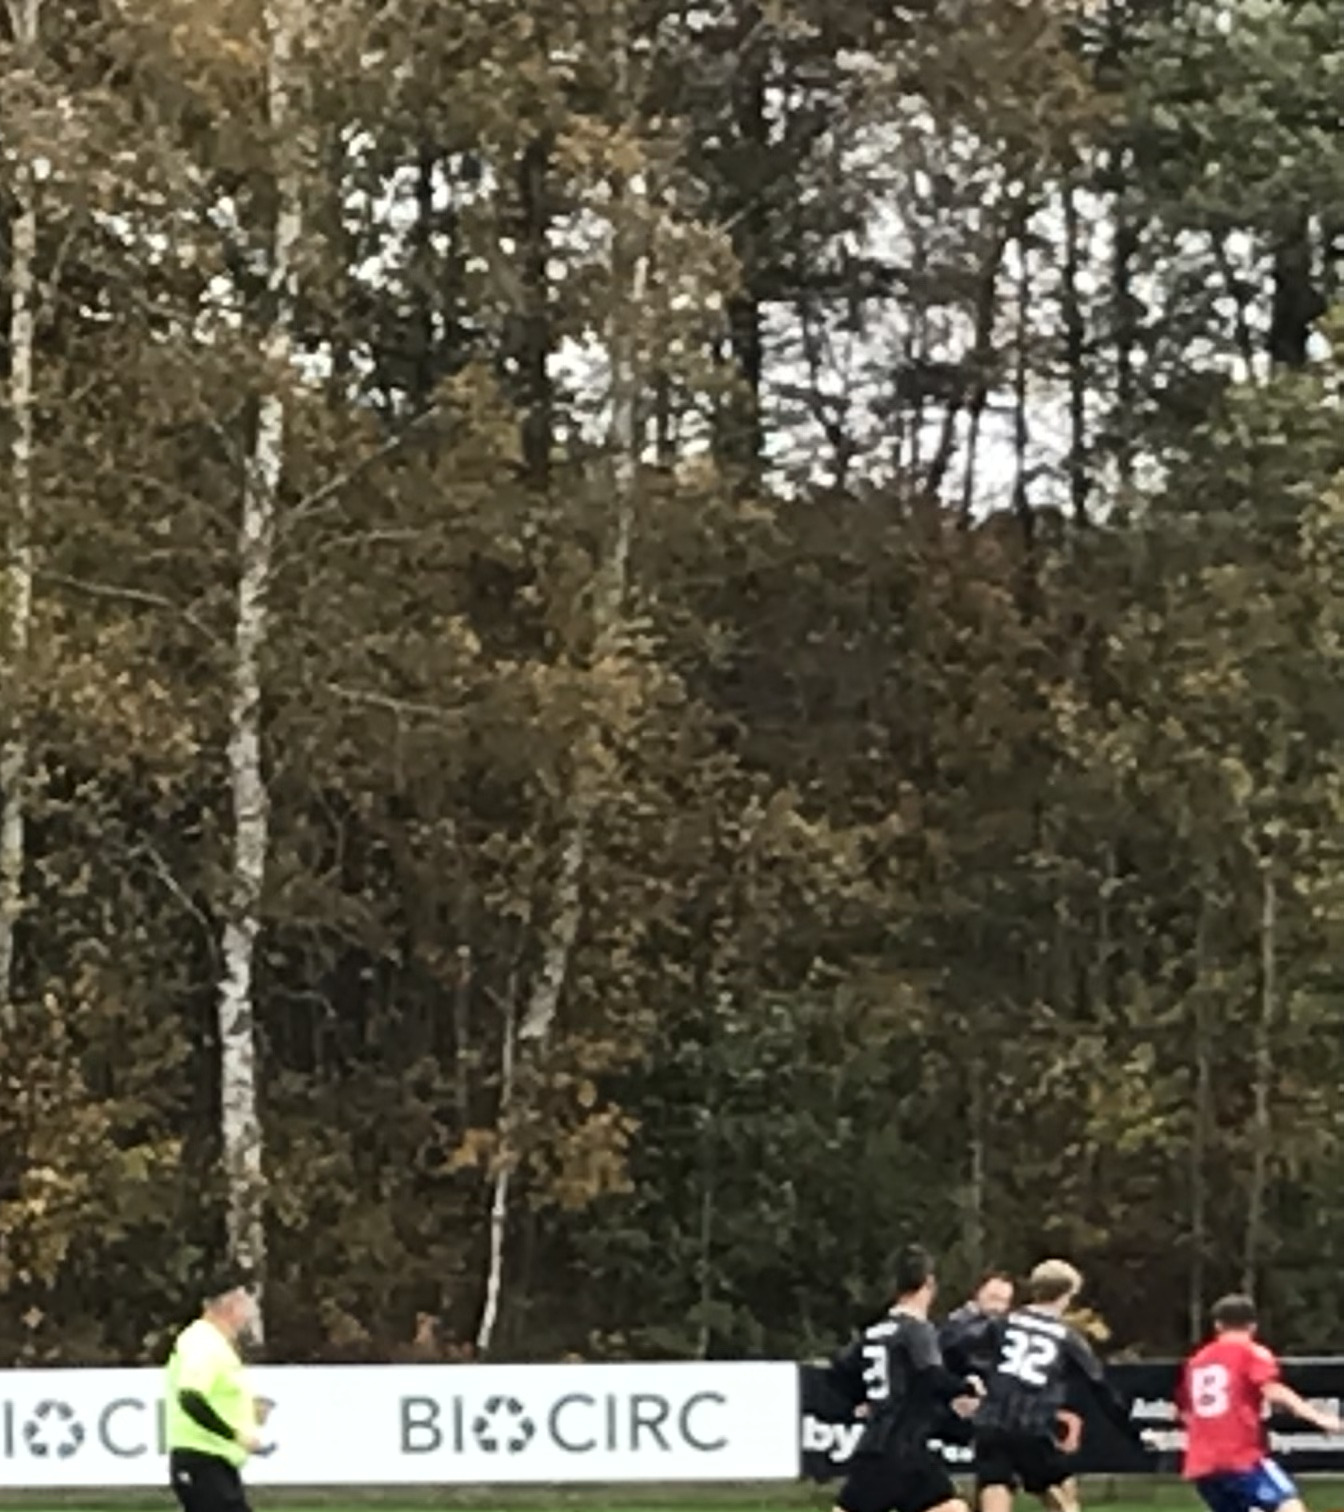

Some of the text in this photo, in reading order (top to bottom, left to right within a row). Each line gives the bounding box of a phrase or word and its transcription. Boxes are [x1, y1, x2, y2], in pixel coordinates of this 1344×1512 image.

[997, 1329, 1059, 1386] 32
[1190, 1363, 1229, 1418] 8
[400, 1391, 728, 1454] BIOCIRC
